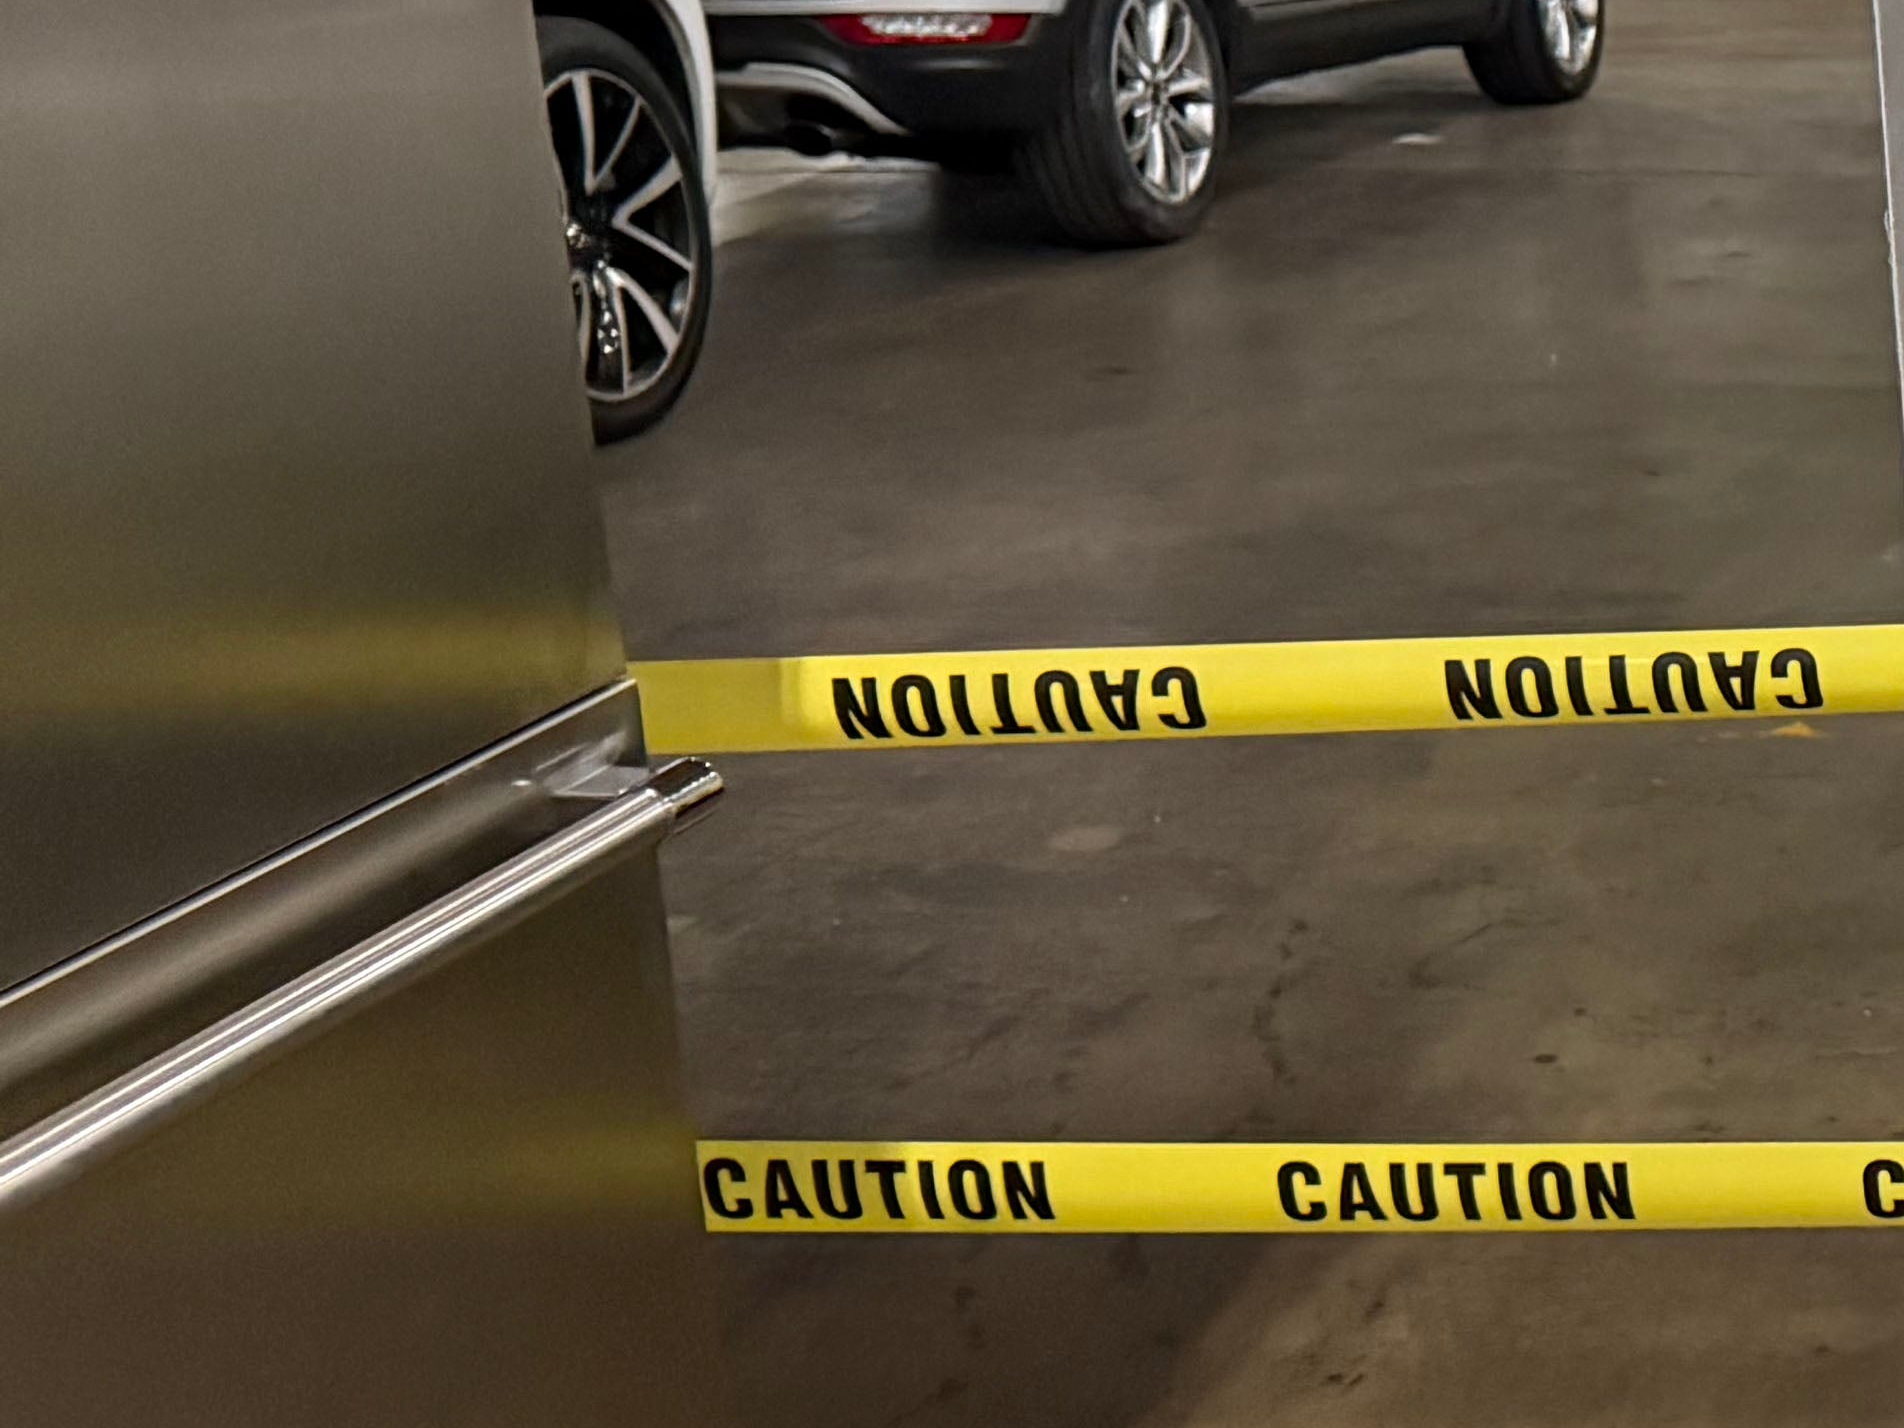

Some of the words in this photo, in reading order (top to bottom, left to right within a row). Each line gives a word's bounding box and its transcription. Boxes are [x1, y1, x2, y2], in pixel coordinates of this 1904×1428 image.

[832, 667, 1208, 740] CAUTION
[1444, 648, 1825, 720] CAUTION
[702, 1157, 1056, 1221] CAUTION
[1276, 1161, 1636, 1222] CAUTION
